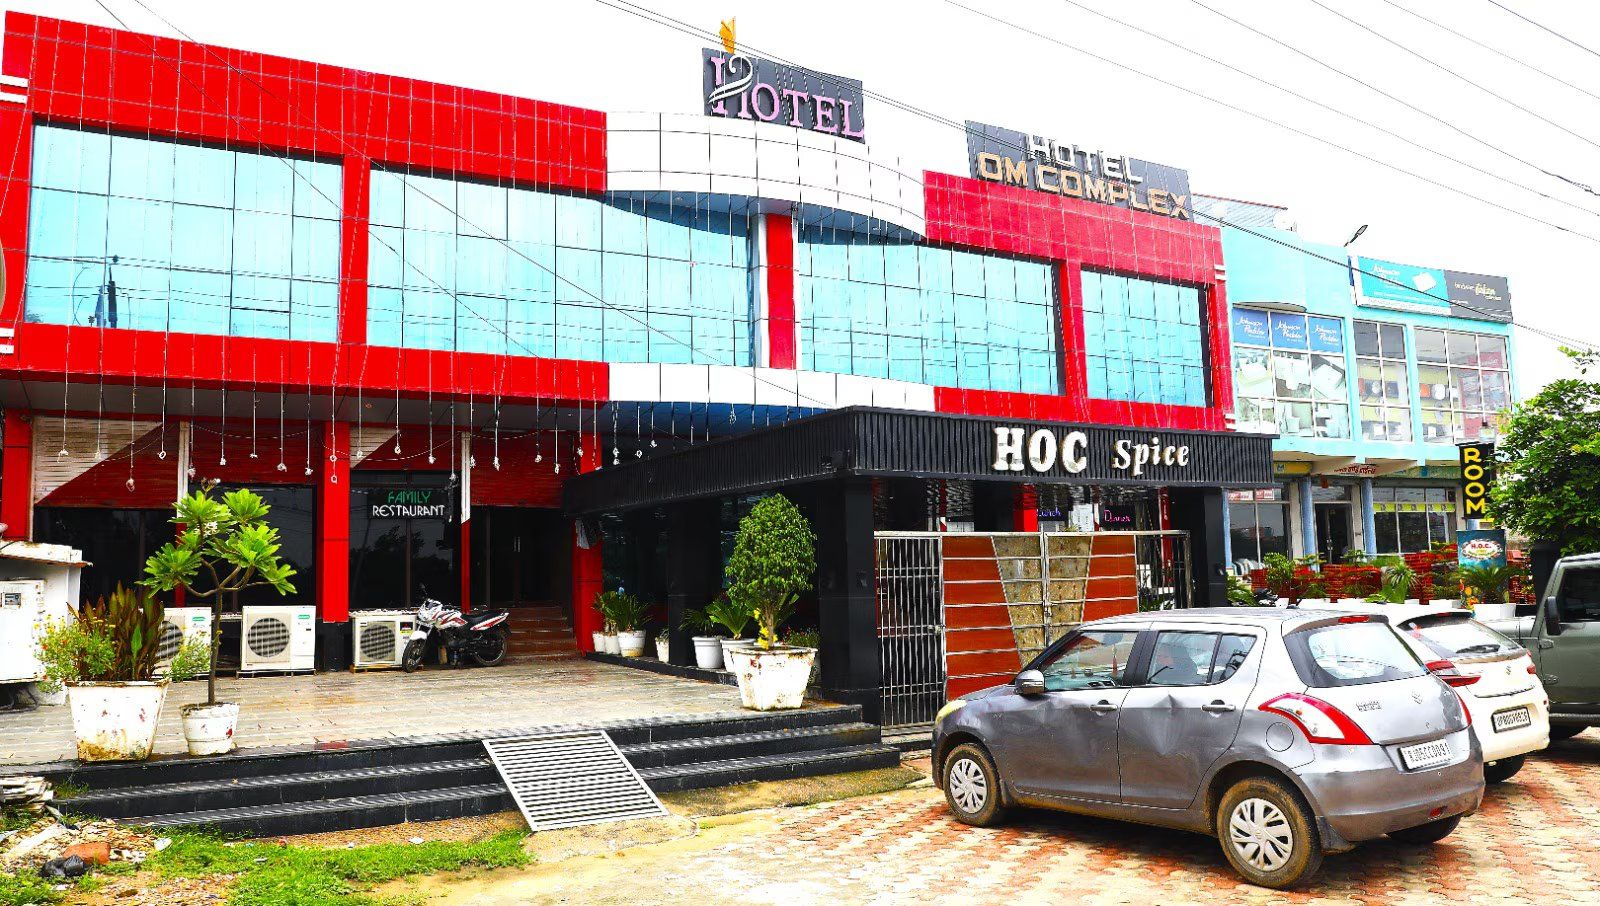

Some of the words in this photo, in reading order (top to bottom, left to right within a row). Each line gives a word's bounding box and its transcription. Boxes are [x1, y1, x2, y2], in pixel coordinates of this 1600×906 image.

[708, 55, 864, 138] HOTEL
[1026, 132, 1143, 184] HOTEL
[978, 151, 1028, 187] OM
[1036, 164, 1190, 220] COMPLEX
[1236, 316, 1263, 327] Johnson
[1275, 320, 1301, 331] Johnson
[1311, 324, 1337, 335] Johnson
[992, 426, 1088, 474] HOC
[1111, 436, 1190, 477] Spice
[387, 490, 432, 504] FAMILY
[1463, 447, 1486, 515] ROOM
[372, 504, 446, 517] RESTAURANT
